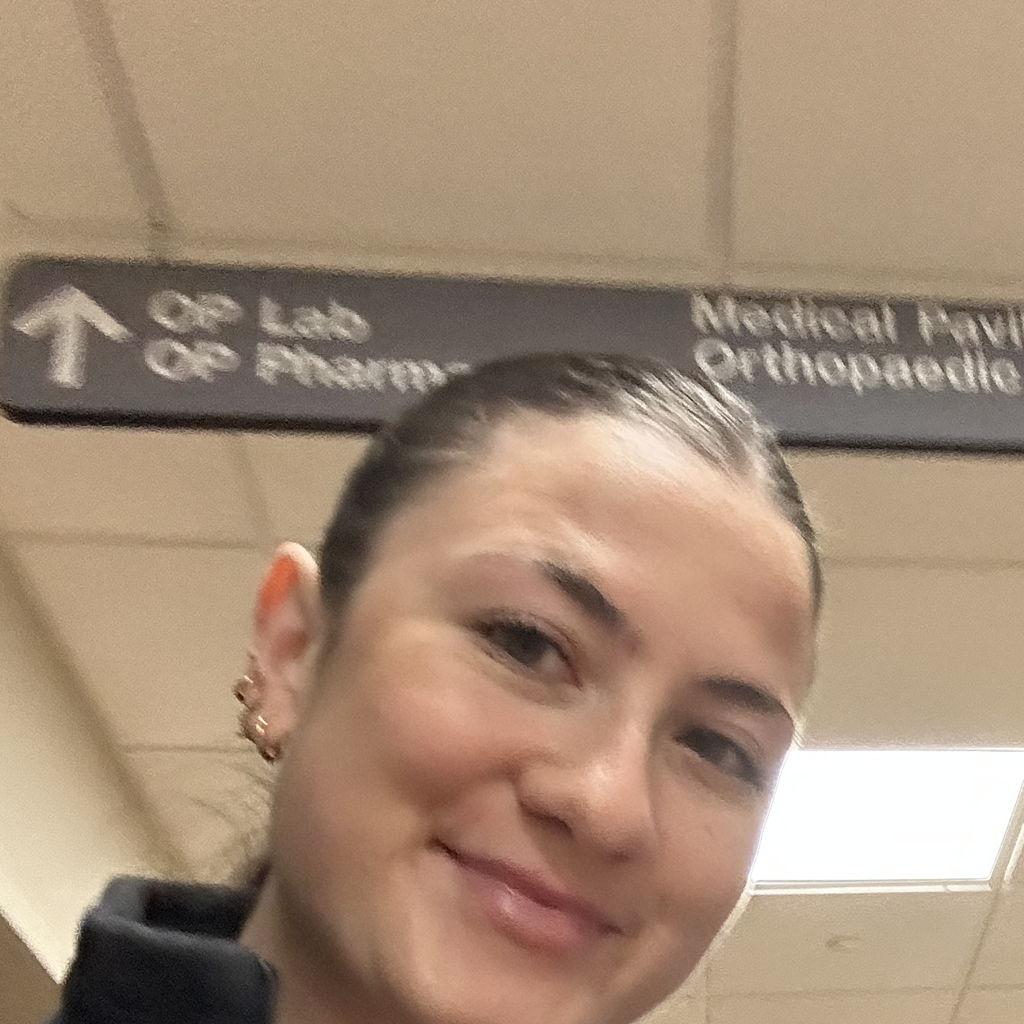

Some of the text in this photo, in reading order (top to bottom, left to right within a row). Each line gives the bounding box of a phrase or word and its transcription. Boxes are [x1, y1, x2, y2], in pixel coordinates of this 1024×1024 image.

[148, 290, 370, 344] OP Lab
[691, 294, 898, 345] Medical
[144, 338, 241, 382] OP
[694, 337, 1021, 397] Orthopaedic
